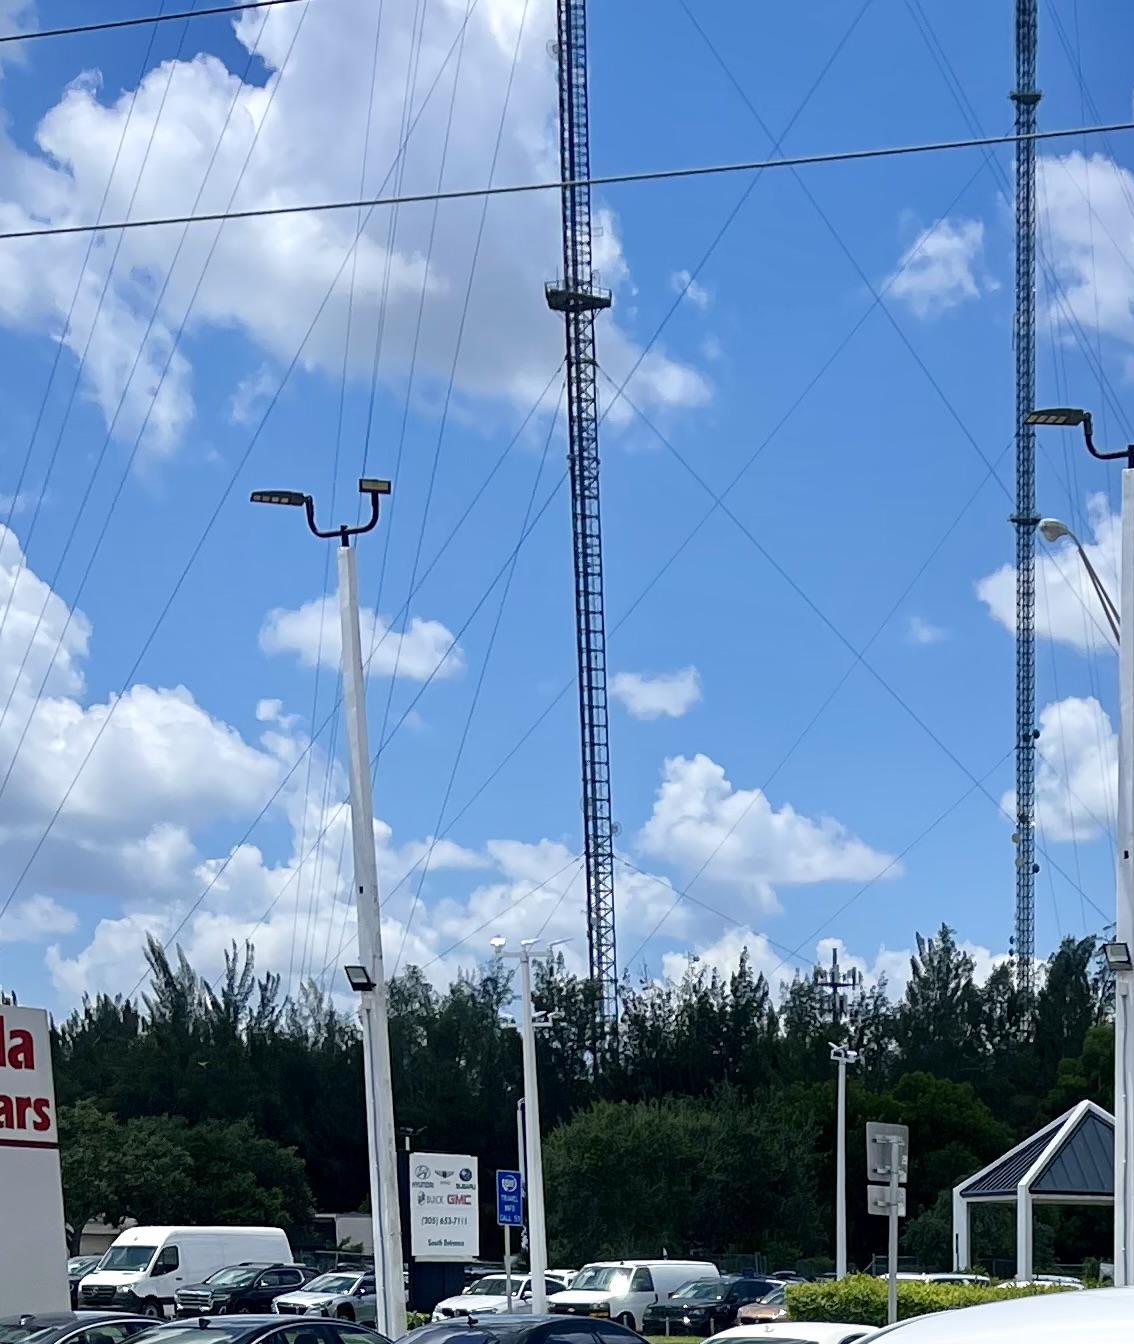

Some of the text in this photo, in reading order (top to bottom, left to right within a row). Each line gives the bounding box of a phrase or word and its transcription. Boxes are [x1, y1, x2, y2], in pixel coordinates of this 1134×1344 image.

[0, 1015, 34, 1070] a
[427, 1195, 444, 1204] BUICK
[447, 1194, 471, 1205] GMC
